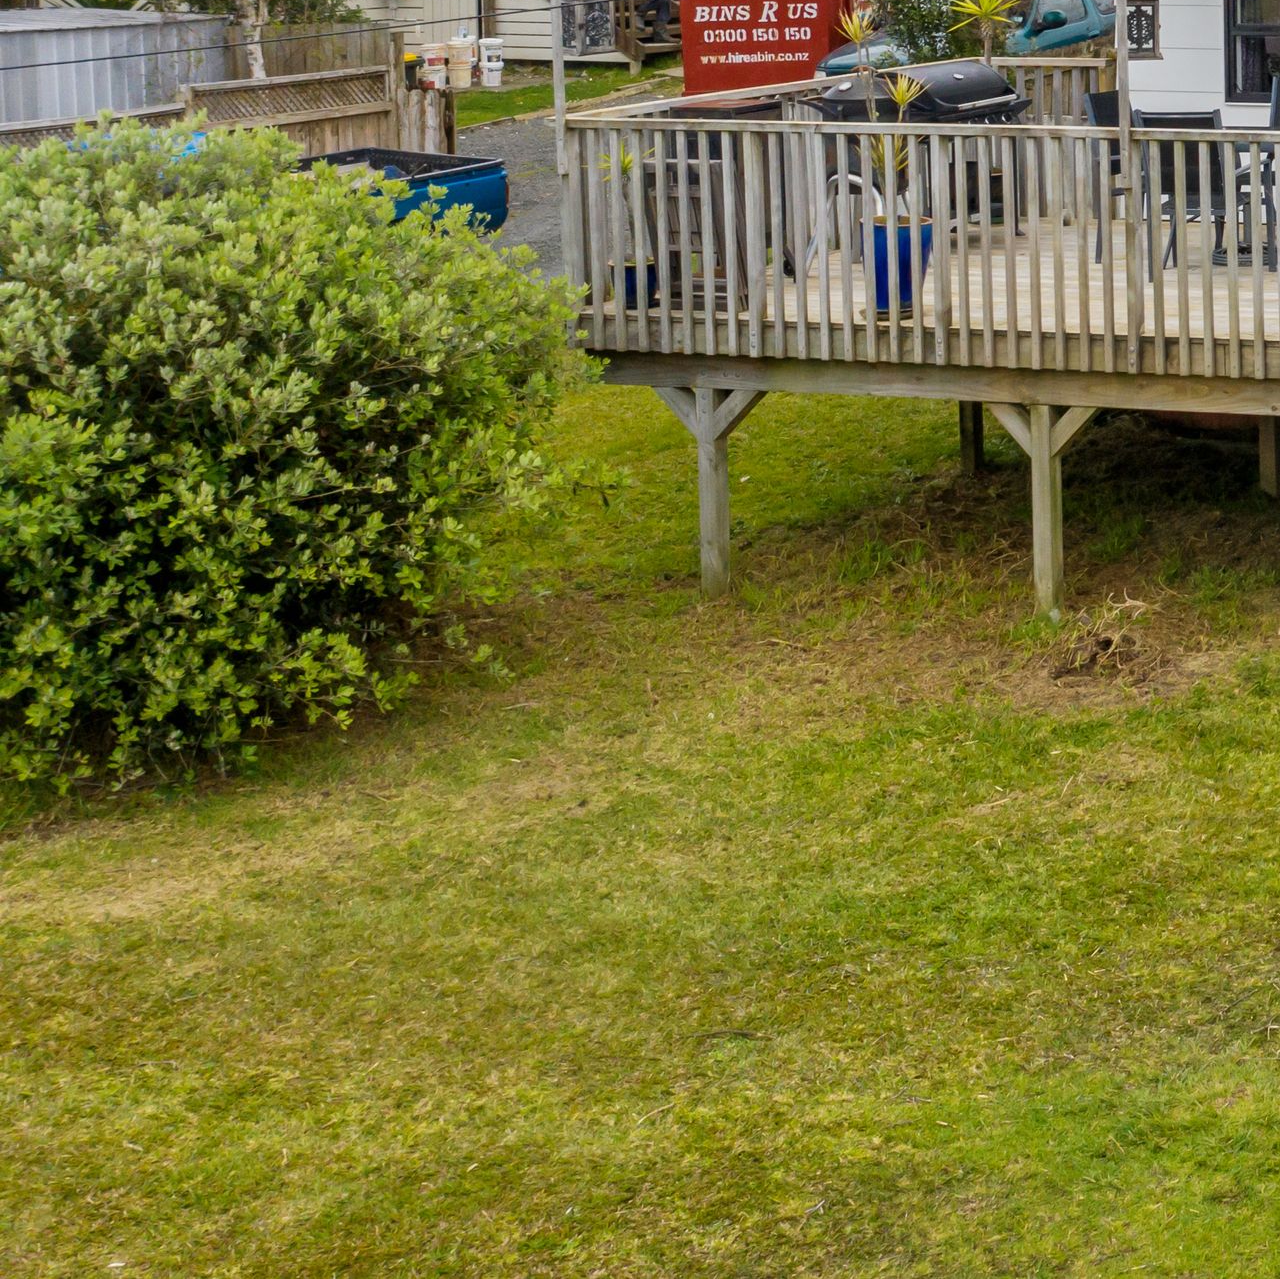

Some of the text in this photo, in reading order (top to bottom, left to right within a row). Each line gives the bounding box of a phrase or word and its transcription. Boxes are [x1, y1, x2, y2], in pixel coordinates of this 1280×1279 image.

[694, 1, 818, 23] BINS R US
[752, 28, 779, 42] 150
[784, 27, 811, 41] 150
[700, 51, 809, 64] www.hireabin.co.nz
